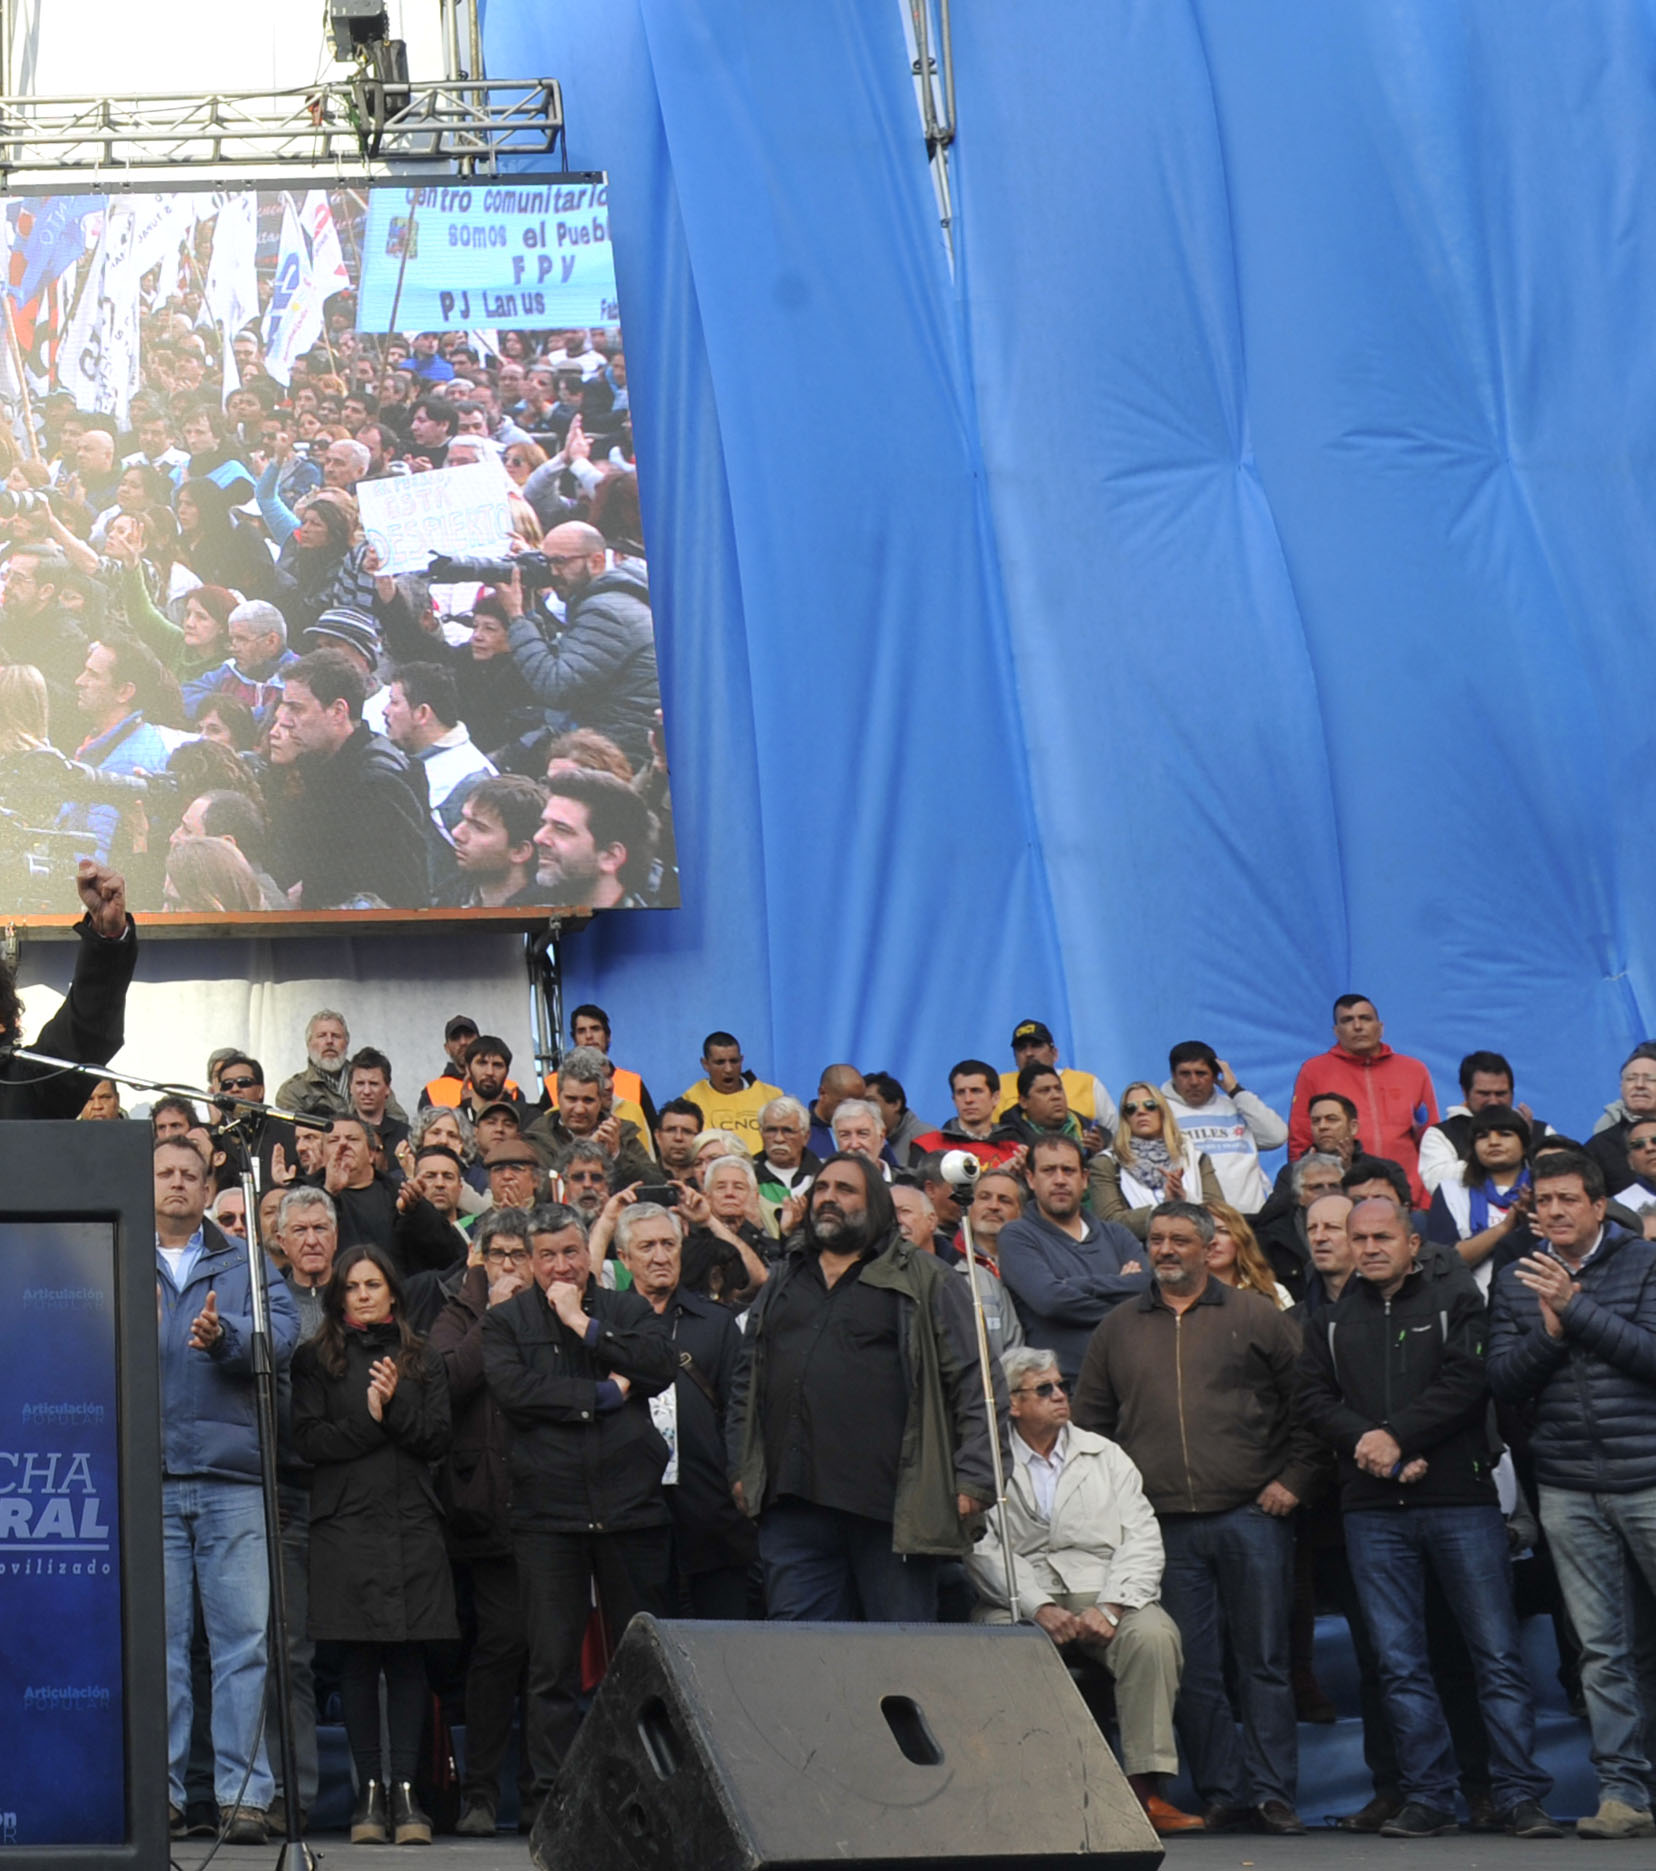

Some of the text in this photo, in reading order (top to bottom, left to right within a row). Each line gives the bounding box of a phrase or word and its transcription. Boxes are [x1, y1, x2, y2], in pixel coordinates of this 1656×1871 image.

[448, 223, 507, 249] somos
[522, 221, 546, 248] el
[439, 290, 470, 321] PJ
[23, 1287, 104, 1301] Articulación
[22, 1401, 104, 1415] Articulación
[23, 1685, 110, 1700] Articulación
